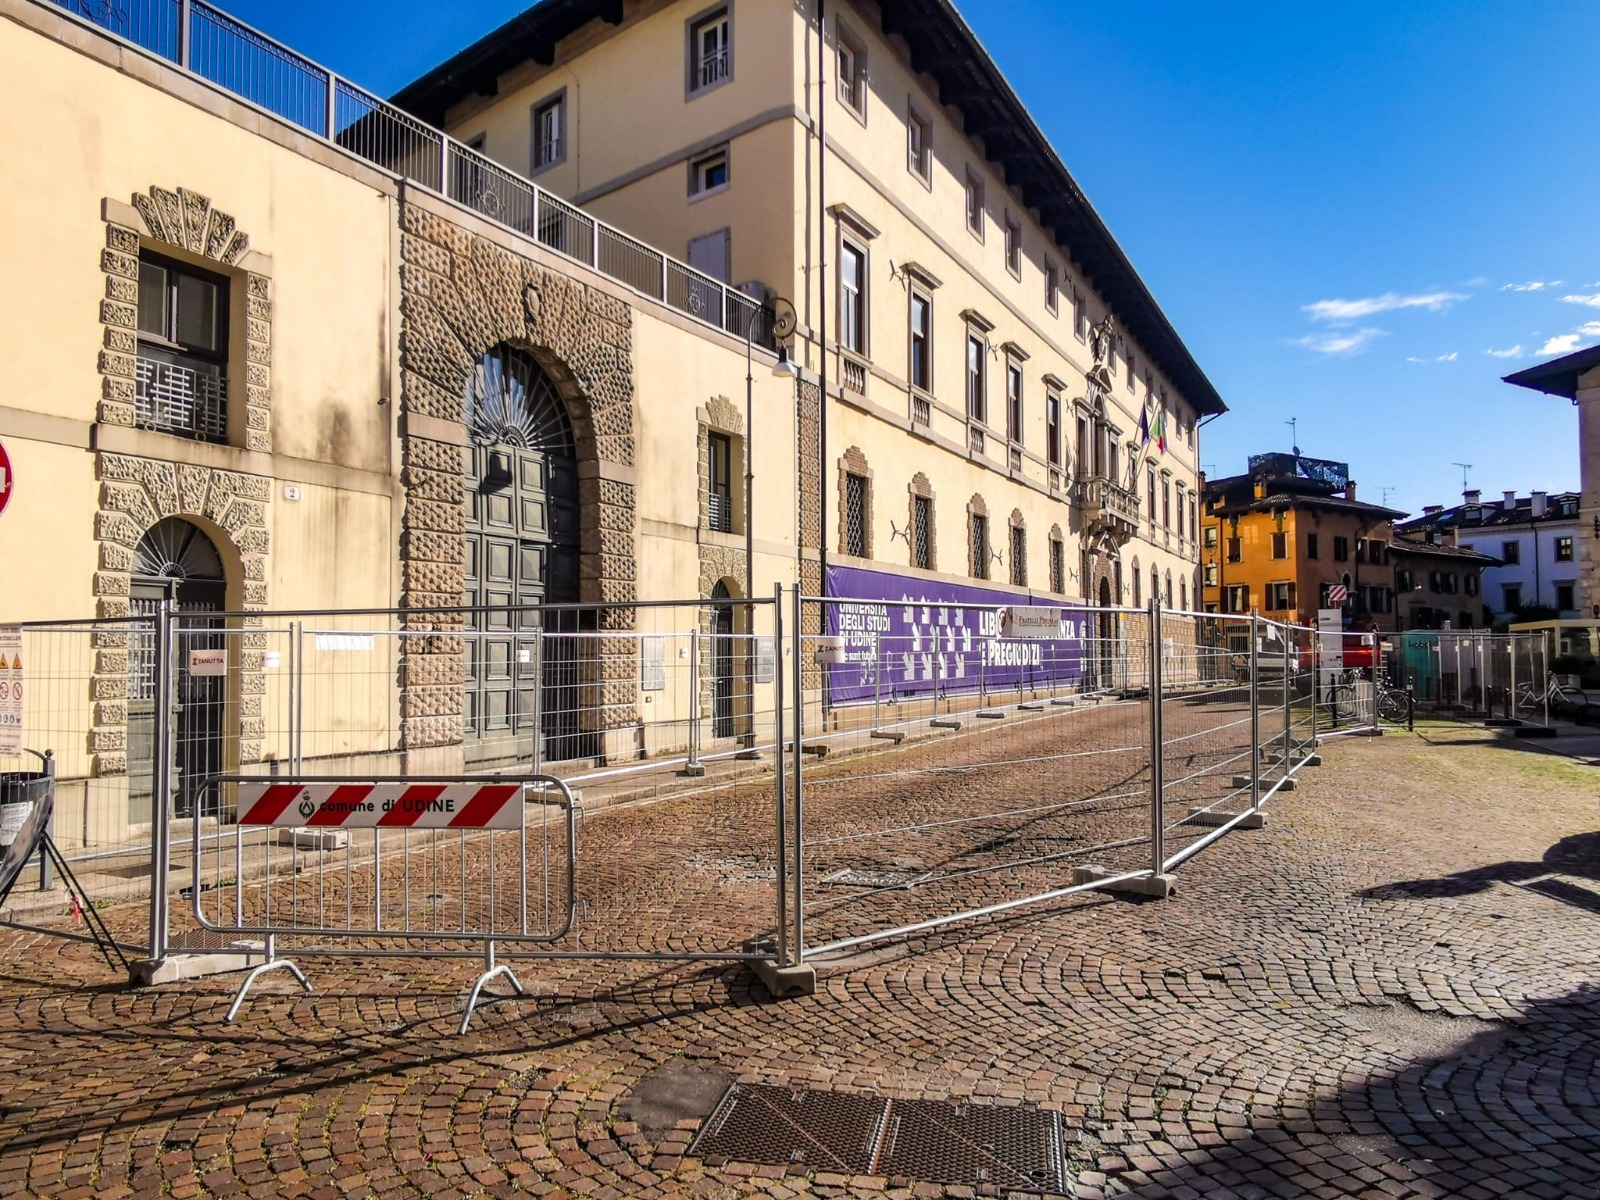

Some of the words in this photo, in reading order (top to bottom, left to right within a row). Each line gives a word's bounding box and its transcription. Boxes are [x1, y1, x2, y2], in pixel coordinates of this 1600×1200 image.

[289, 487, 296, 498] 2
[839, 613, 865, 630] DEGLI
[867, 615, 891, 632] STUDI
[851, 630, 877, 647] UDINE
[987, 641, 1040, 667] PREGIUDIZI
[319, 802, 375, 812] comune
[382, 799, 394, 812] di
[403, 799, 455, 812] UDINE
